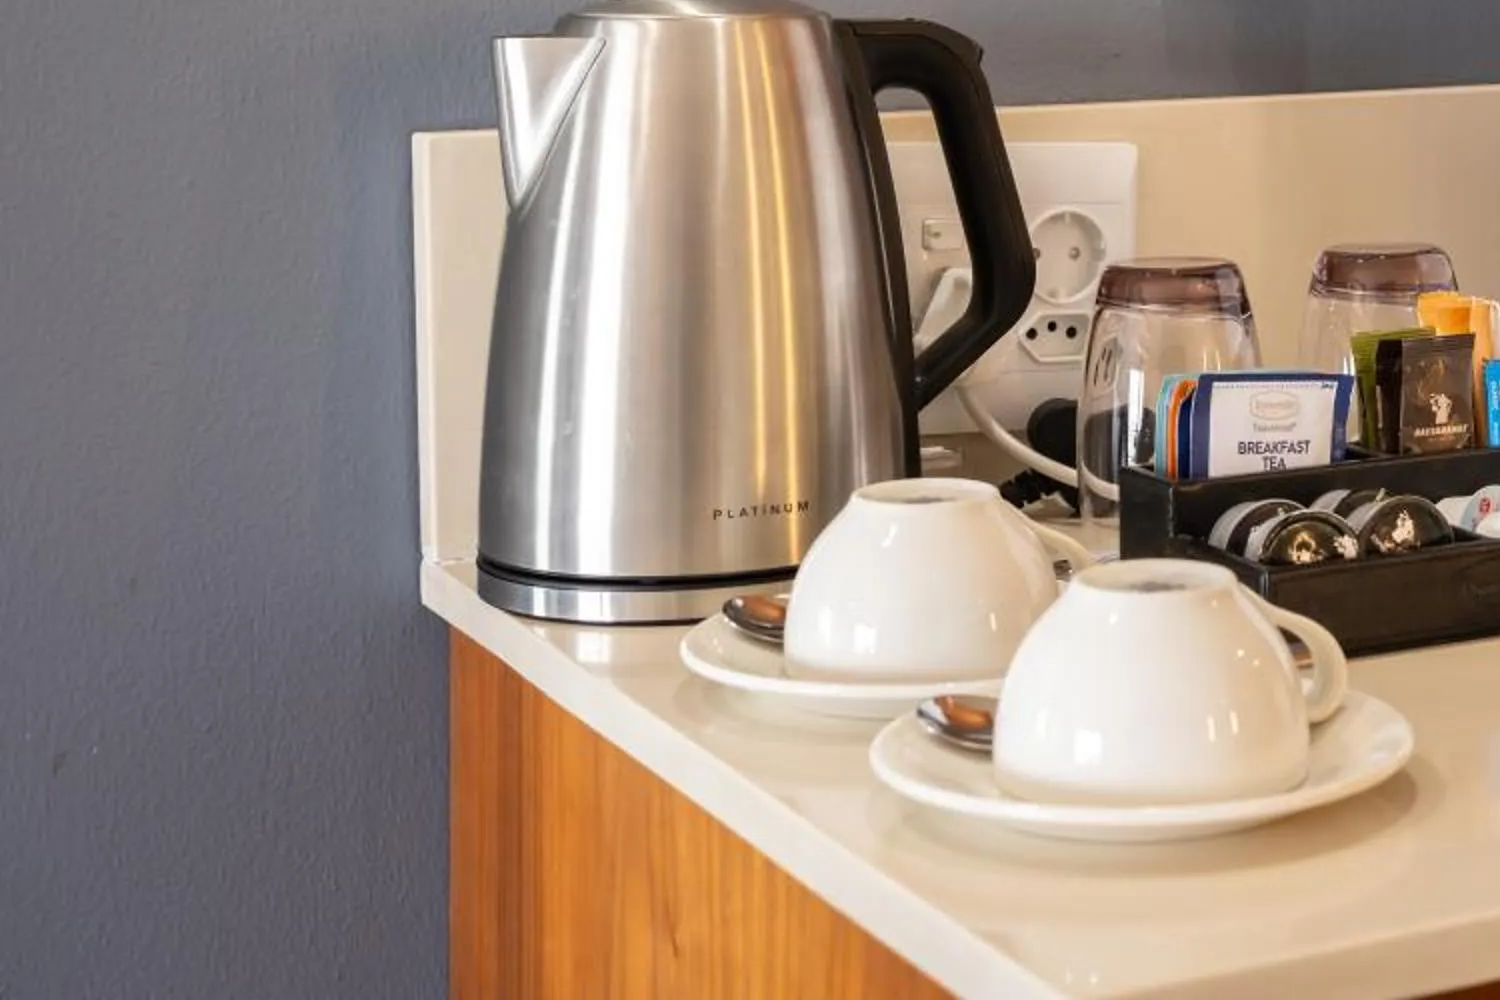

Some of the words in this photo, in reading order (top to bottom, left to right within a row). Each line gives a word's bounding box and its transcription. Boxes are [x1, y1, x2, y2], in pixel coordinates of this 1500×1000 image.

[1237, 440, 1311, 455] BREAKFAST
[1262, 456, 1287, 472] TEA
[713, 501, 809, 520] PLATINUM
